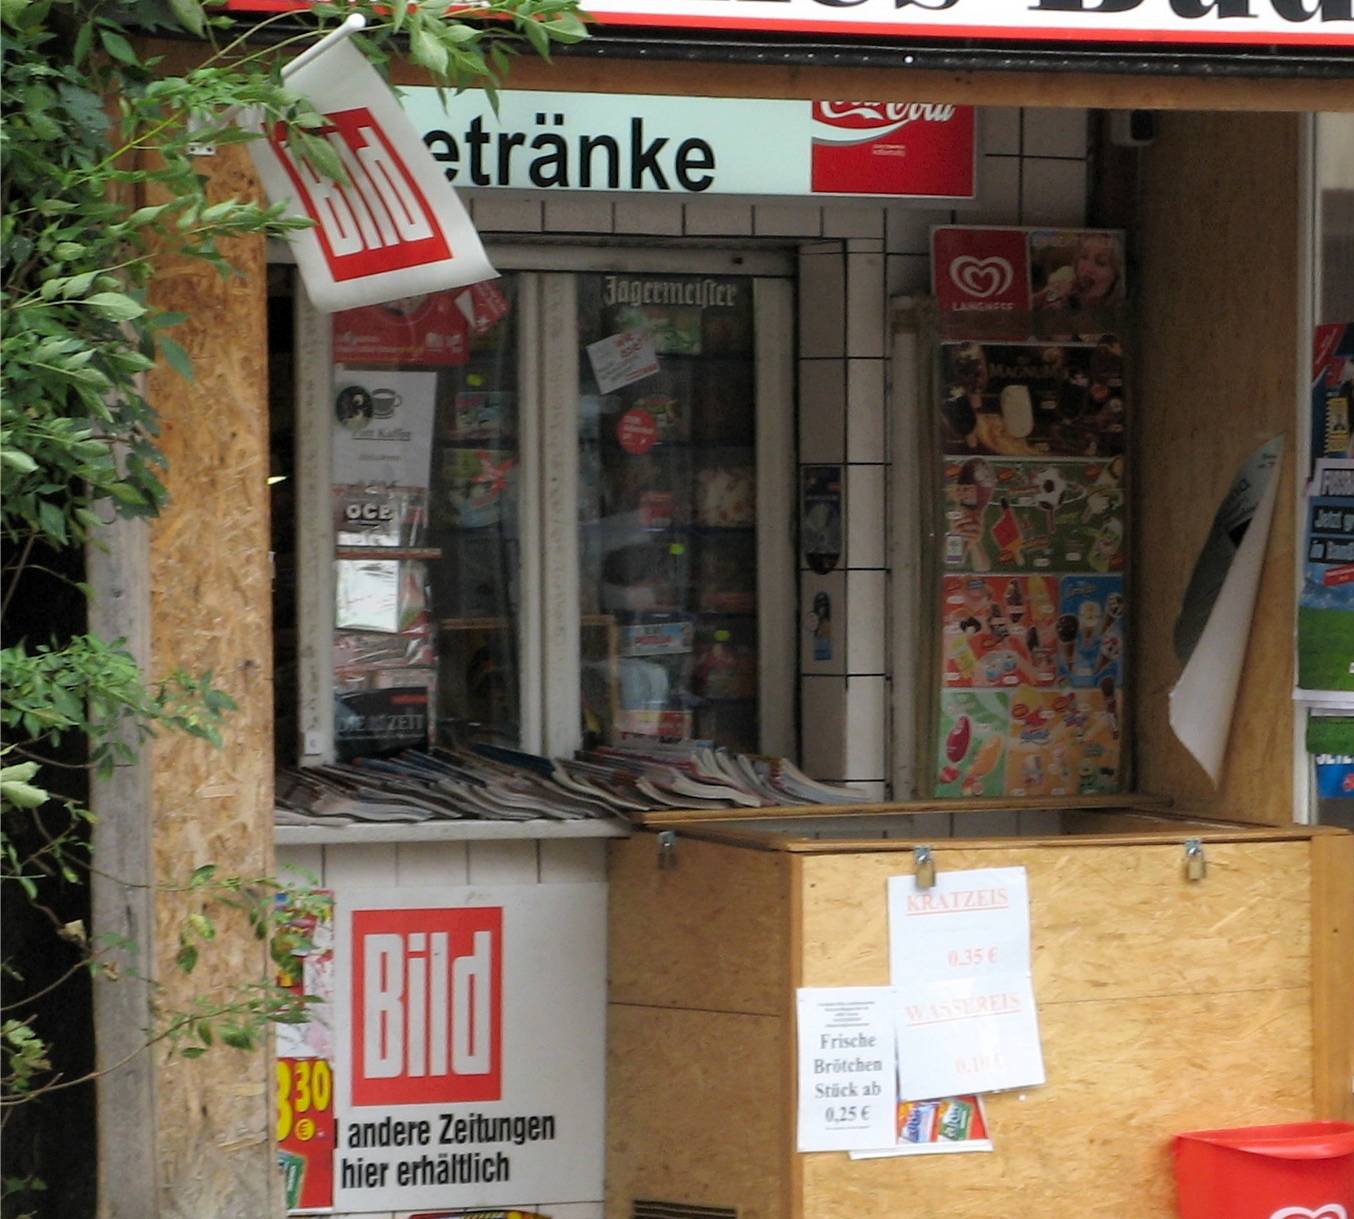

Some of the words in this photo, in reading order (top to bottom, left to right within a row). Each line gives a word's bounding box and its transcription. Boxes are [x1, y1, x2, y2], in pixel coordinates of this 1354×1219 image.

[422, 112, 716, 192] etränke
[907, 888, 1009, 912] KRATZEIS
[364, 930, 492, 1079] Bild
[906, 993, 1021, 1022] WASSEREIS
[820, 1033, 877, 1050] Frische
[813, 1057, 882, 1075] Brötchen
[814, 1082, 858, 1099] Stück
[862, 1080, 881, 1097] ab
[825, 1106, 857, 1123] 0,25
[860, 1105, 871, 1121] €
[348, 1117, 430, 1148] andere
[439, 1113, 555, 1145] Zeitungen
[342, 1158, 388, 1189] hier
[397, 1152, 510, 1187] erhältlich
